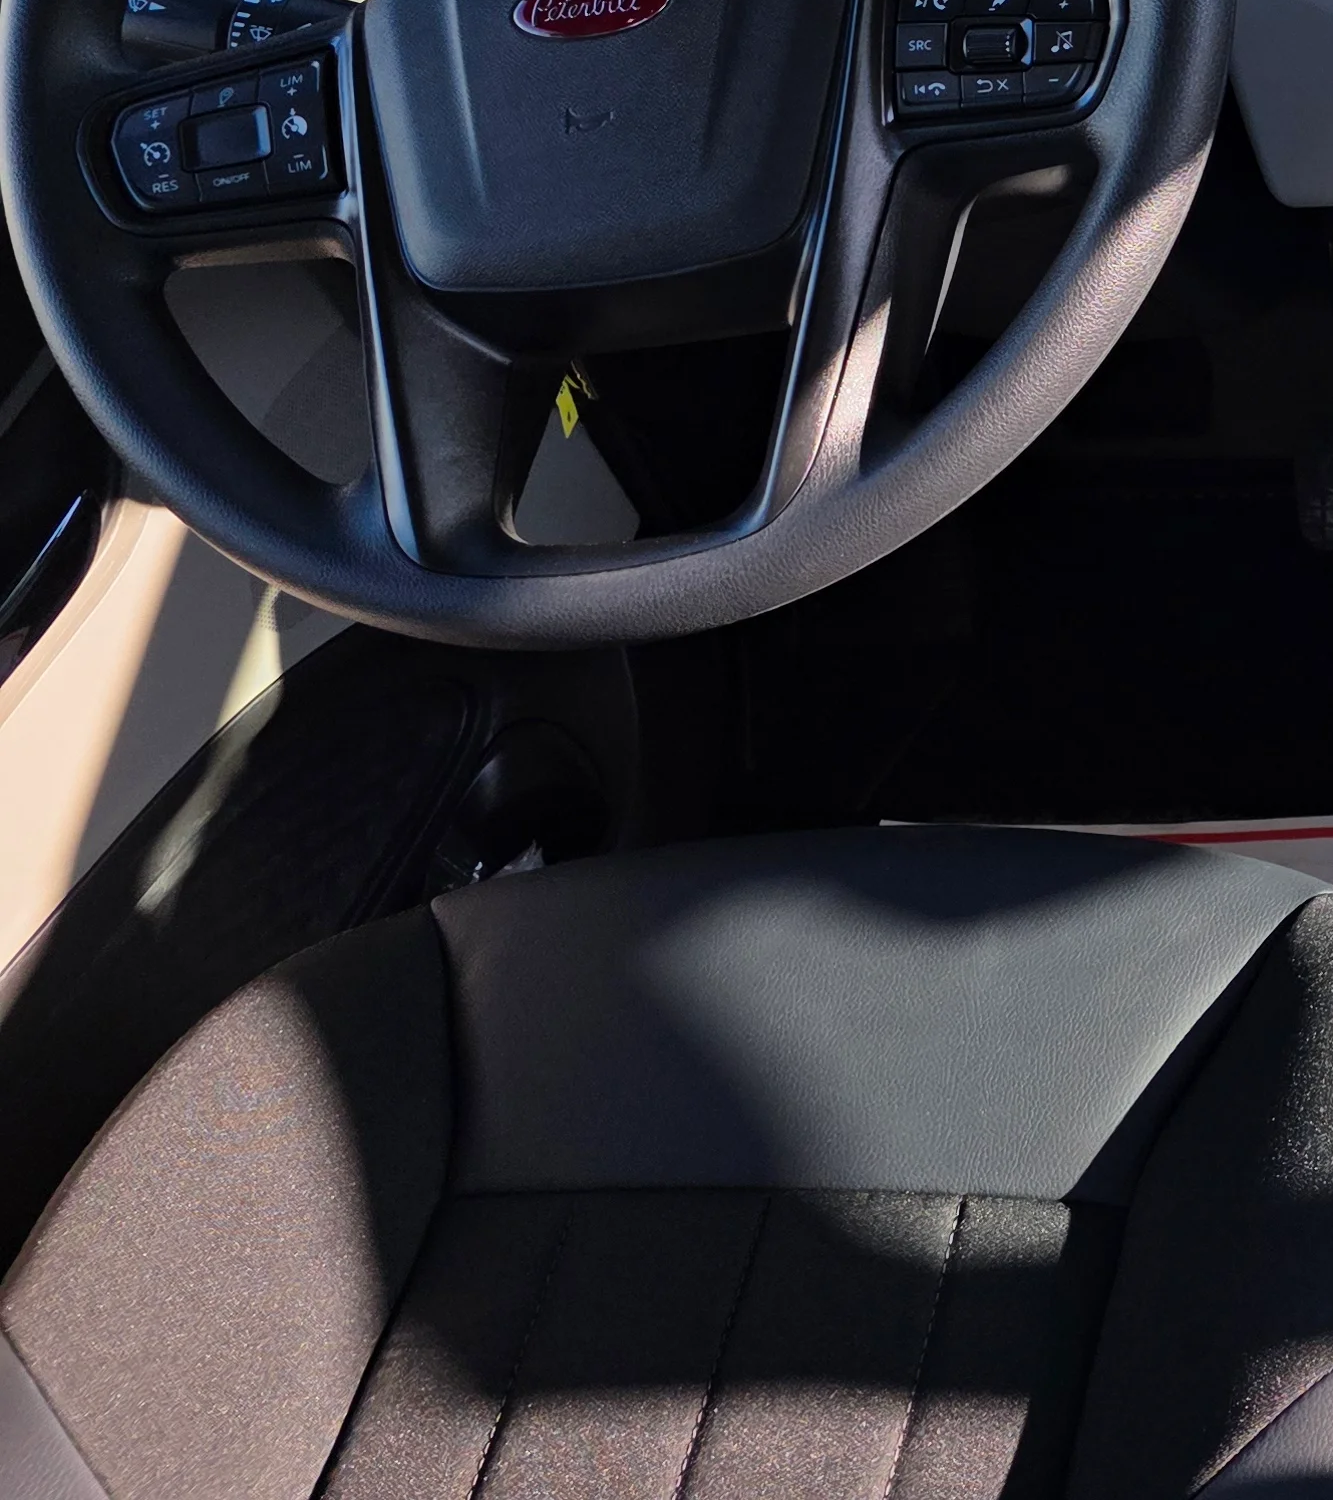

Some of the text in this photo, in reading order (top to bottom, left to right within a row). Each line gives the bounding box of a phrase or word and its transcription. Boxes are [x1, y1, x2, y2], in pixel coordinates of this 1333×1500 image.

[908, 39, 932, 51] SRC
[280, 74, 304, 88] LIM
[143, 106, 169, 120] SET
[287, 159, 312, 174] LIM
[152, 179, 179, 194] RES
[212, 172, 250, 187] ON/OFF
